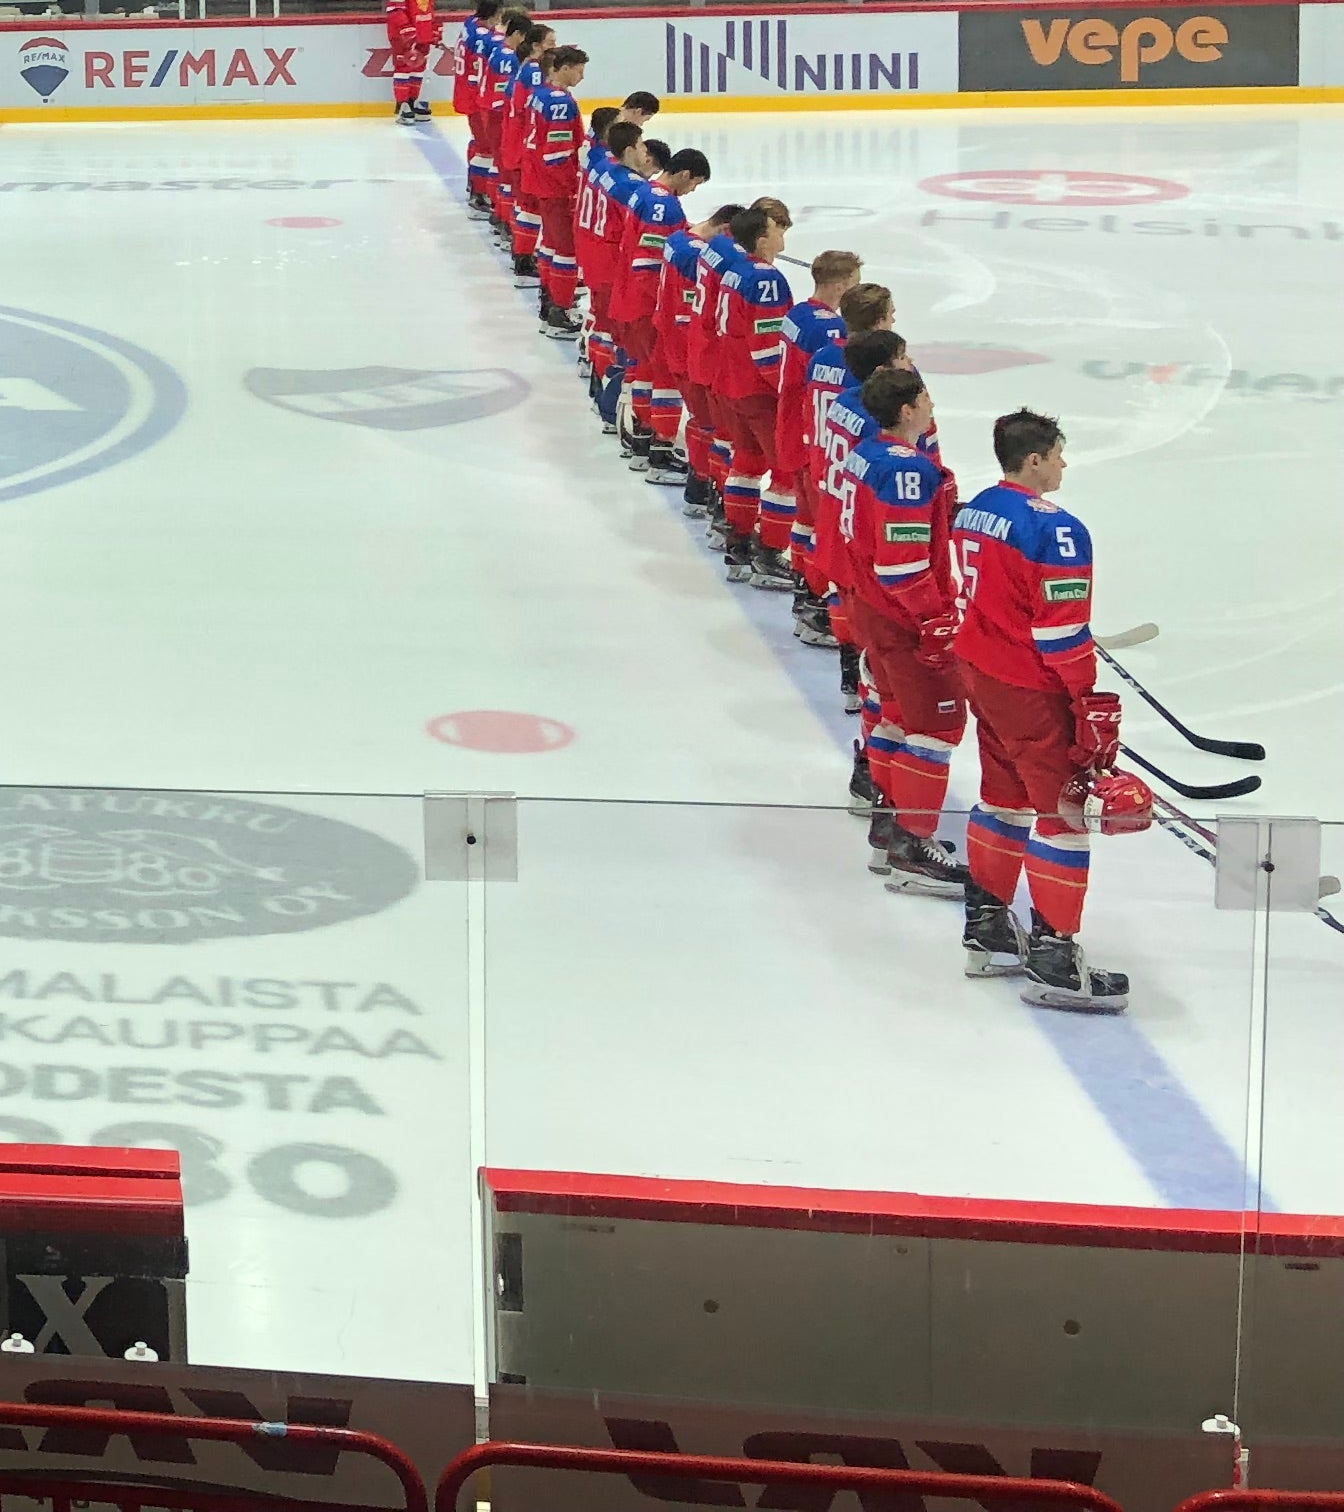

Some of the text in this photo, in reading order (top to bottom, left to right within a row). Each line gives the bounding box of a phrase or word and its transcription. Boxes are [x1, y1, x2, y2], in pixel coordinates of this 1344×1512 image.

[23, 51, 66, 65] RE/MAX
[1020, 16, 1229, 83] vepe
[84, 48, 297, 89] RE/MAX
[794, 52, 919, 91] NIINI
[550, 104, 568, 121] 22
[651, 203, 664, 222] 3
[758, 280, 779, 303] 21
[895, 470, 922, 501] 18
[1055, 526, 1077, 558] 5
